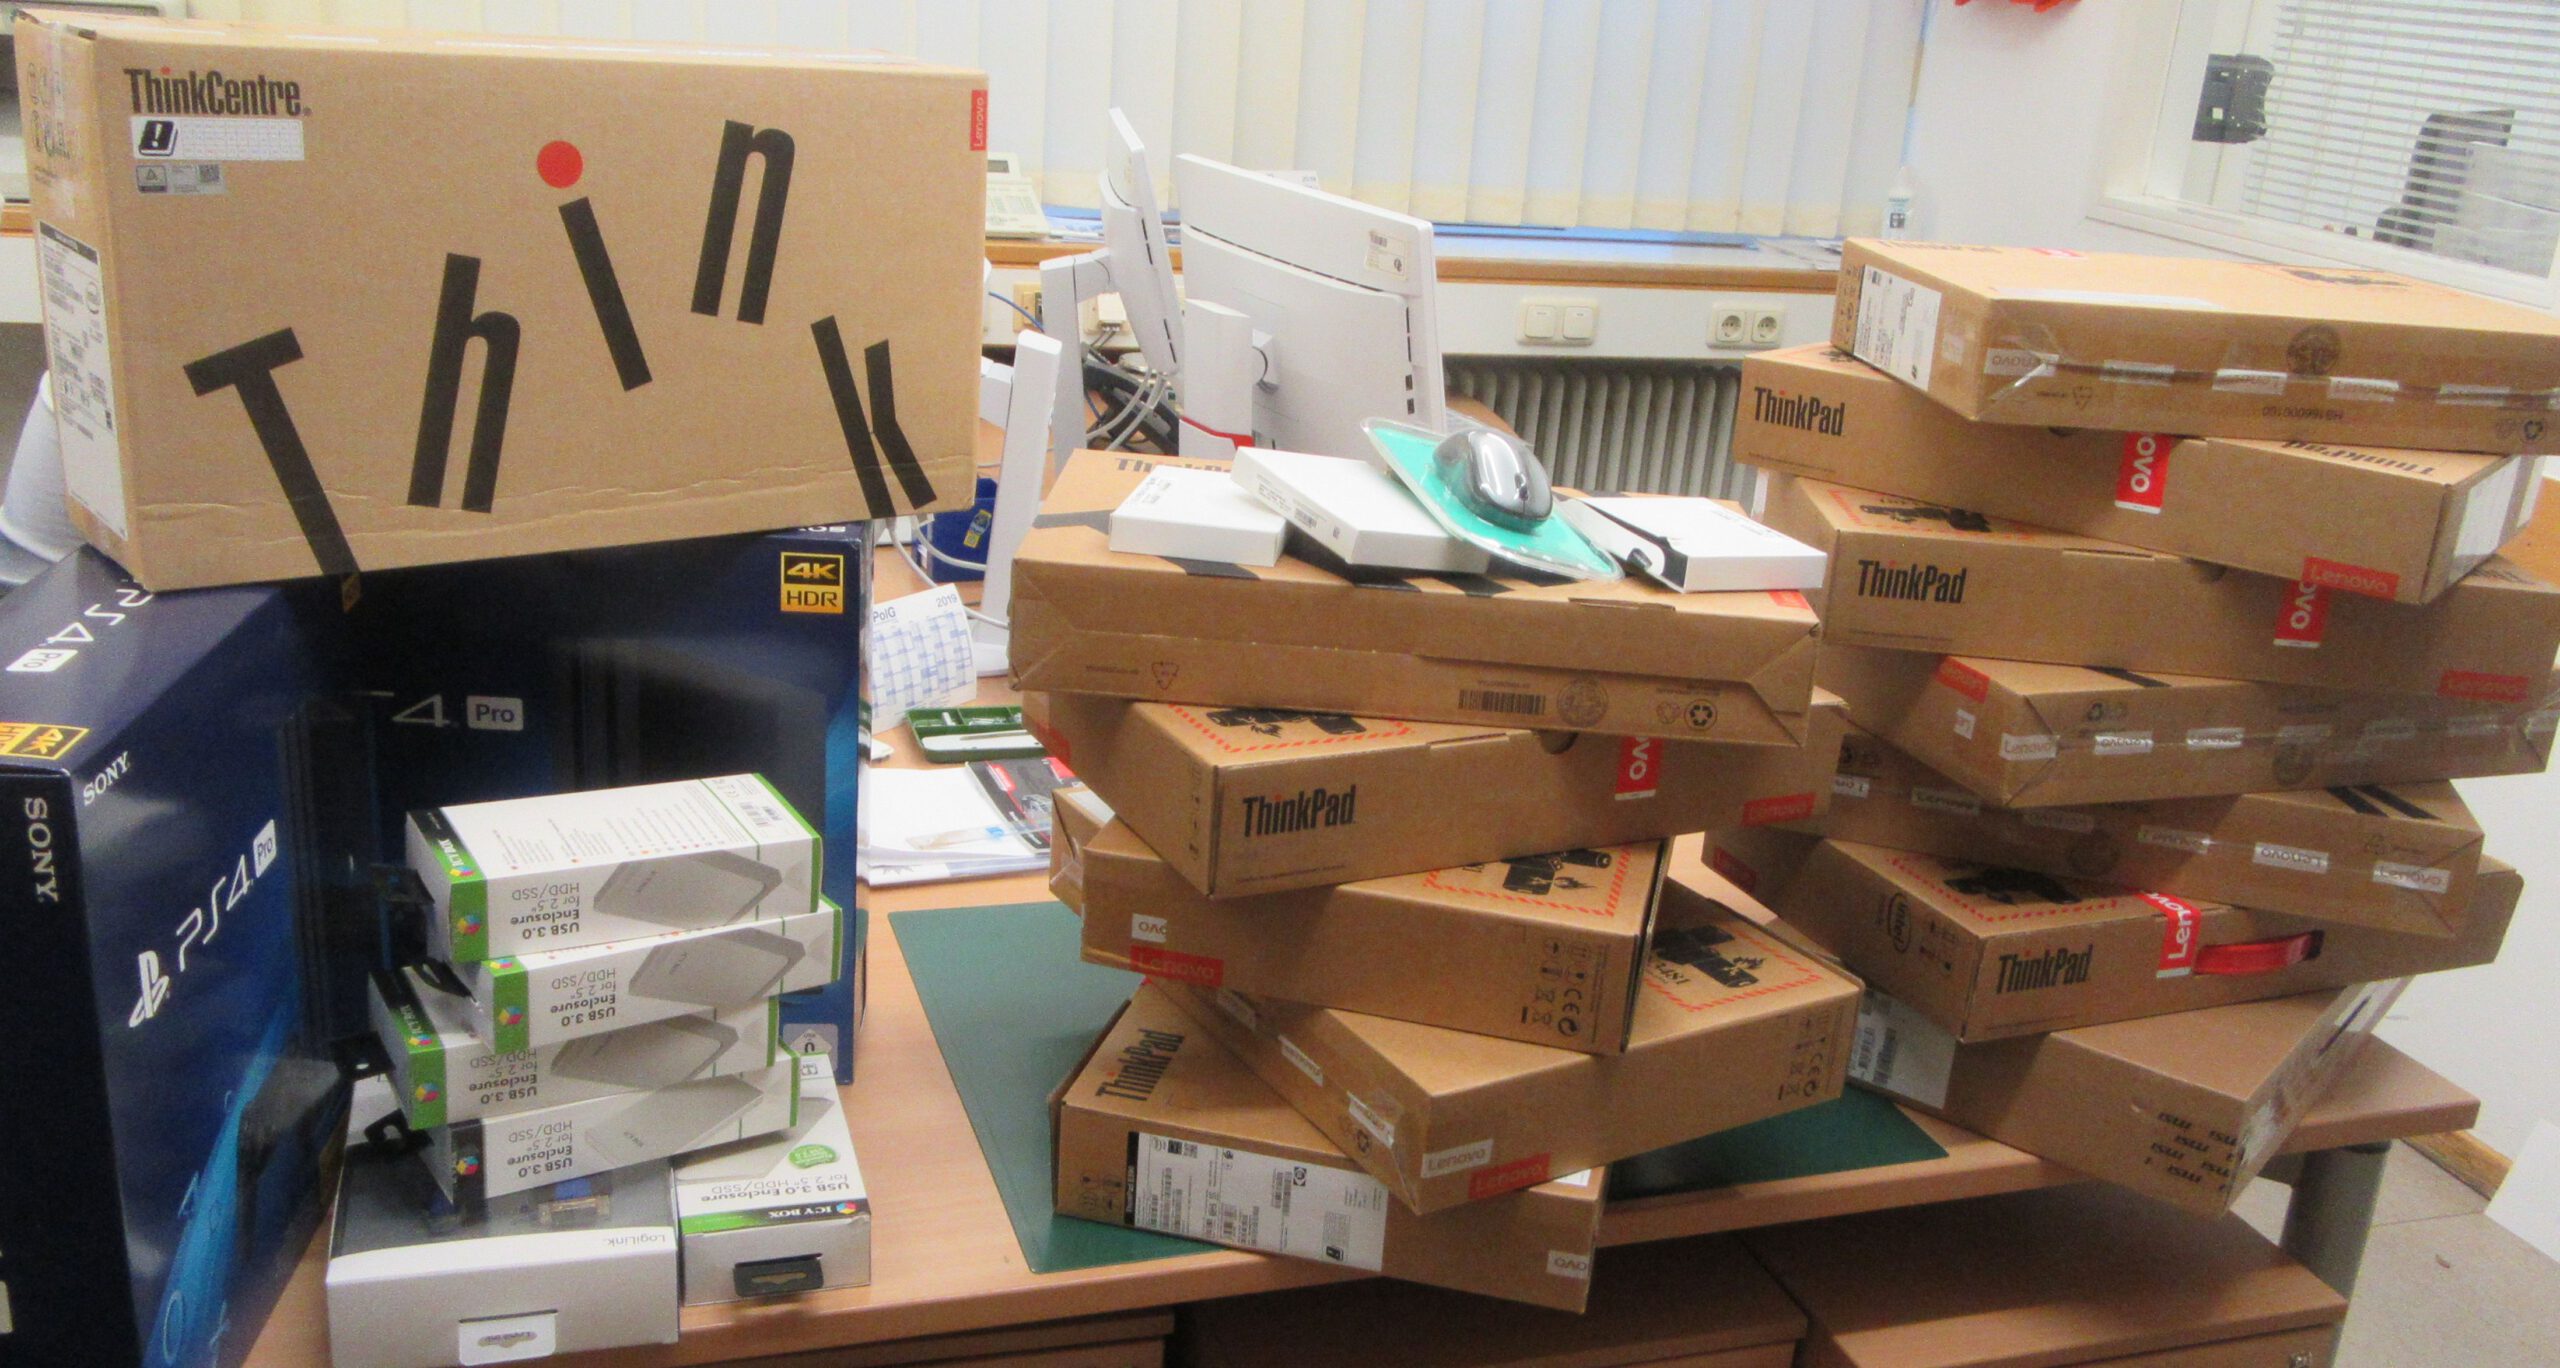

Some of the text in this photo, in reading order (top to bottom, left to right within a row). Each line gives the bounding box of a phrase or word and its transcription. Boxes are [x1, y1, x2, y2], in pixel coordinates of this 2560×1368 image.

[124, 66, 301, 117] ThinkCentre
[975, 96, 985, 148] Lenovo
[1753, 385, 1846, 438] ThinkPad
[786, 561, 838, 582] 4K
[1857, 559, 1968, 604] ThinkPad
[2309, 563, 2389, 593] Lenovo
[786, 590, 838, 608] HDR
[475, 703, 516, 725] Pro
[1629, 736, 1652, 781] vo
[83, 752, 129, 807] SONY
[1242, 784, 1357, 839] ThinkPad
[25, 797, 59, 903] SONY
[2260, 846, 2322, 868] Lenovo
[511, 882, 580, 901] HDD/SSD
[176, 837, 273, 972] PS4 Pro
[510, 909, 580, 925] Enclosure
[522, 922, 580, 940] USB 3.0
[551, 967, 616, 990] HDD/SSD
[1996, 943, 2094, 996] ThinkPad
[550, 993, 616, 1014] Enclosure
[561, 1006, 616, 1027] USB 3.0
[1095, 1027, 1186, 1100] ThinkPad
[468, 1073, 537, 1092] Enclosure
[480, 1085, 537, 1105] USB 3.0
[508, 1119, 573, 1144] HDD/SSD
[507, 1144, 573, 1166] Enclosure
[1428, 1148, 1487, 1171] Lenovo
[518, 1157, 573, 1178] USB 3.0
[701, 1182, 850, 1202] USB 3.0 Enclosure
[711, 1180, 789, 1195] HDD/SSD
[768, 1205, 832, 1219] ICY BOX
